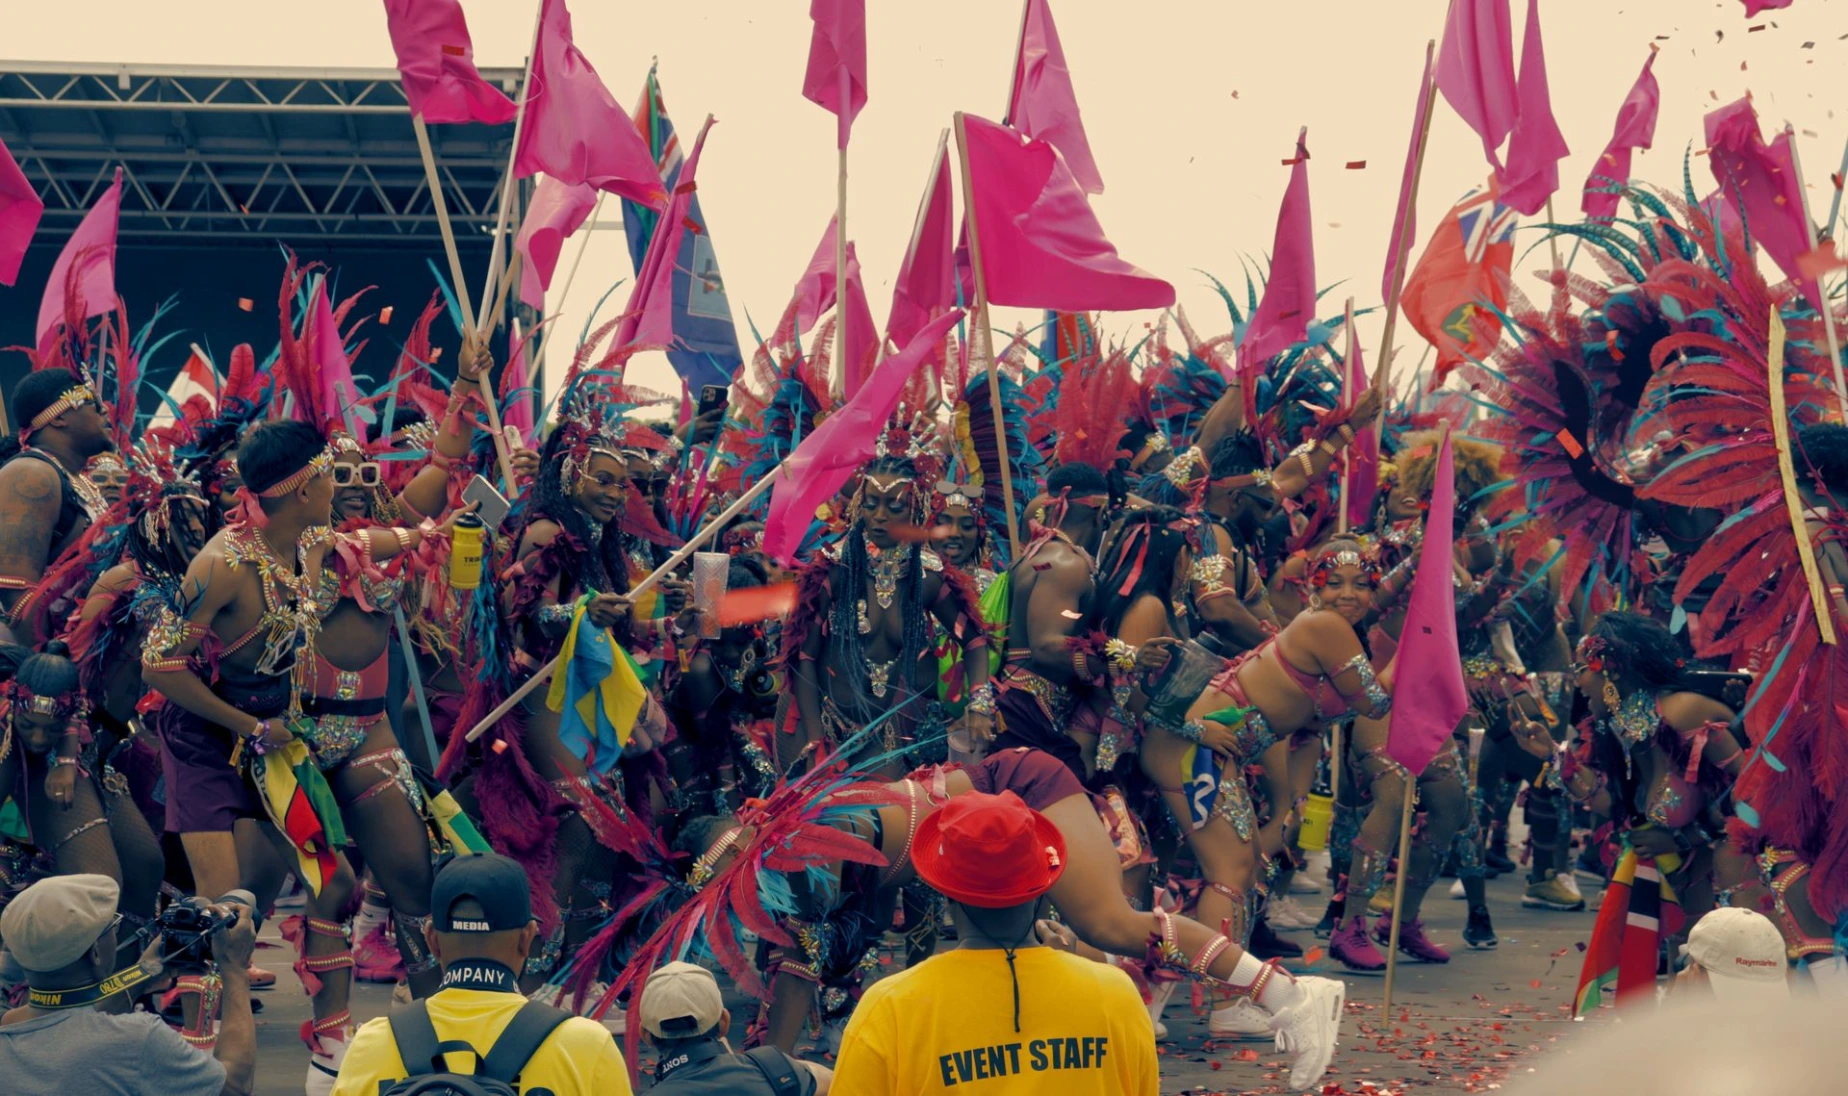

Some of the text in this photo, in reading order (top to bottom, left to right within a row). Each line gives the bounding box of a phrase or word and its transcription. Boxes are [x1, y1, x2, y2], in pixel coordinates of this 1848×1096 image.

[452, 920, 490, 931] MEDIA
[1735, 957, 1778, 967] Raymarine
[101, 977, 124, 994] D780
[439, 967, 505, 989] OMPANY
[29, 993, 62, 1006] Nikon
[662, 1053, 689, 1074] SONY
[939, 1037, 1108, 1087] EVENT STAFF
